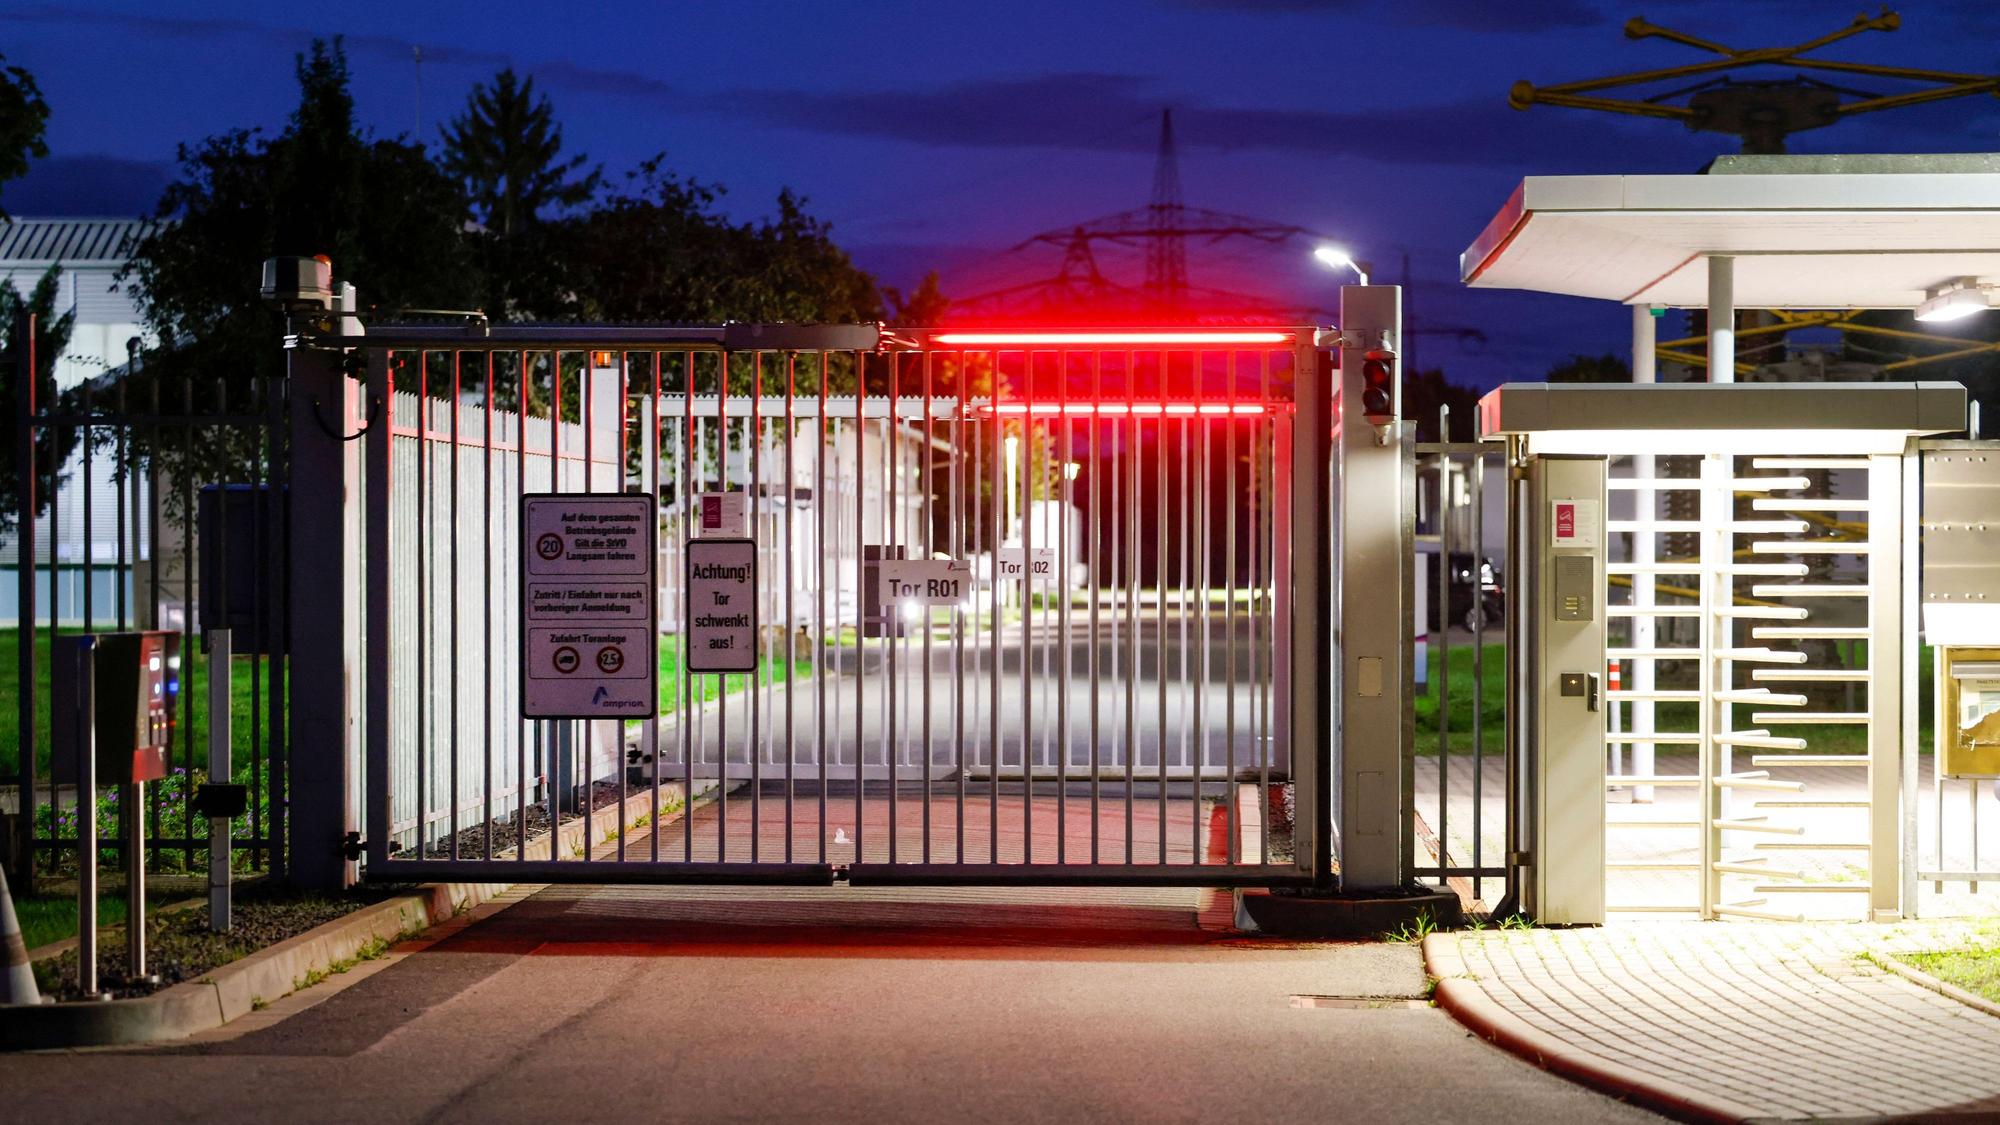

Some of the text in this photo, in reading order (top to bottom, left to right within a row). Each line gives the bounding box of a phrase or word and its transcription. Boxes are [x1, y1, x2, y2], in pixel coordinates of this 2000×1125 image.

[561, 513, 640, 524] Auf dem gesamten
[565, 526, 637, 536] Betriebsgelände
[542, 540, 559, 553] 20
[575, 539, 627, 548] Gilt die StVO
[565, 552, 636, 562] Langsam fahren
[1000, 561, 1049, 573] Tor 02
[692, 563, 751, 583] Achtung!
[889, 579, 959, 597] Tor R01
[534, 590, 560, 599] Zutritt
[568, 590, 602, 599] Einfahrt
[621, 590, 642, 599] nach
[712, 591, 730, 606] Tor
[534, 603, 631, 613] vorheriger Anmeldung
[695, 613, 749, 628] schwenkt
[550, 634, 626, 644] Zufahrt Toranlage
[709, 635, 734, 649] aus!
